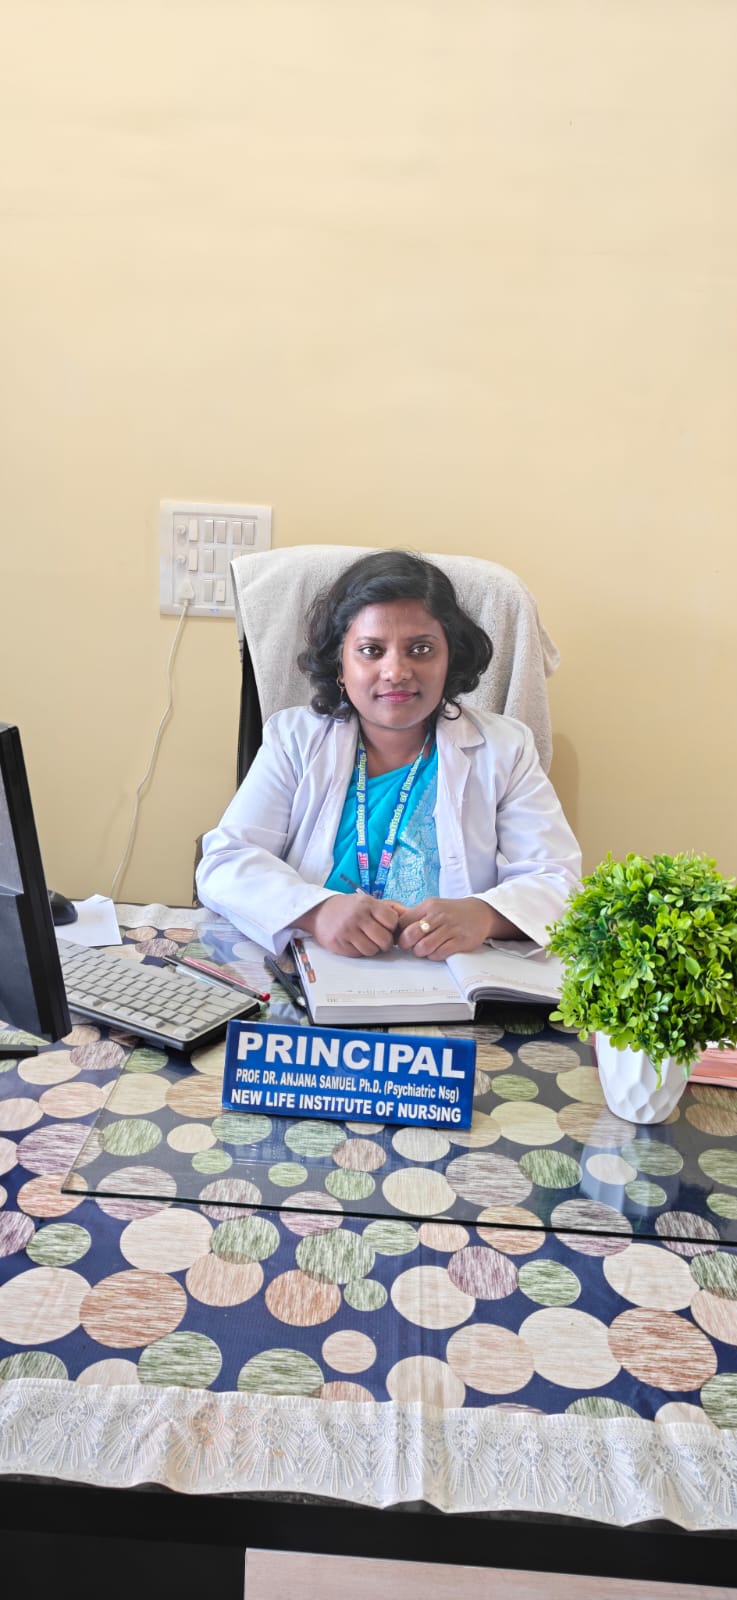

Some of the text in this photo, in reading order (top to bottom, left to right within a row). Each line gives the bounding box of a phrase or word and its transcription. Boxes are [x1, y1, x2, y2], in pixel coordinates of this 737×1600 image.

[357, 791, 366, 803] of
[356, 804, 366, 846] Institute
[385, 804, 404, 845] Institute
[399, 791, 409, 803] of
[237, 1031, 465, 1079] PRINCIPAL
[230, 1088, 462, 1123] NEW LIFE INSTITUTE OF NURSING
[235, 1068, 460, 1104] PROF. DR. ANJANA SAMUEL Ph.D. (Psychiatric Nsg)
